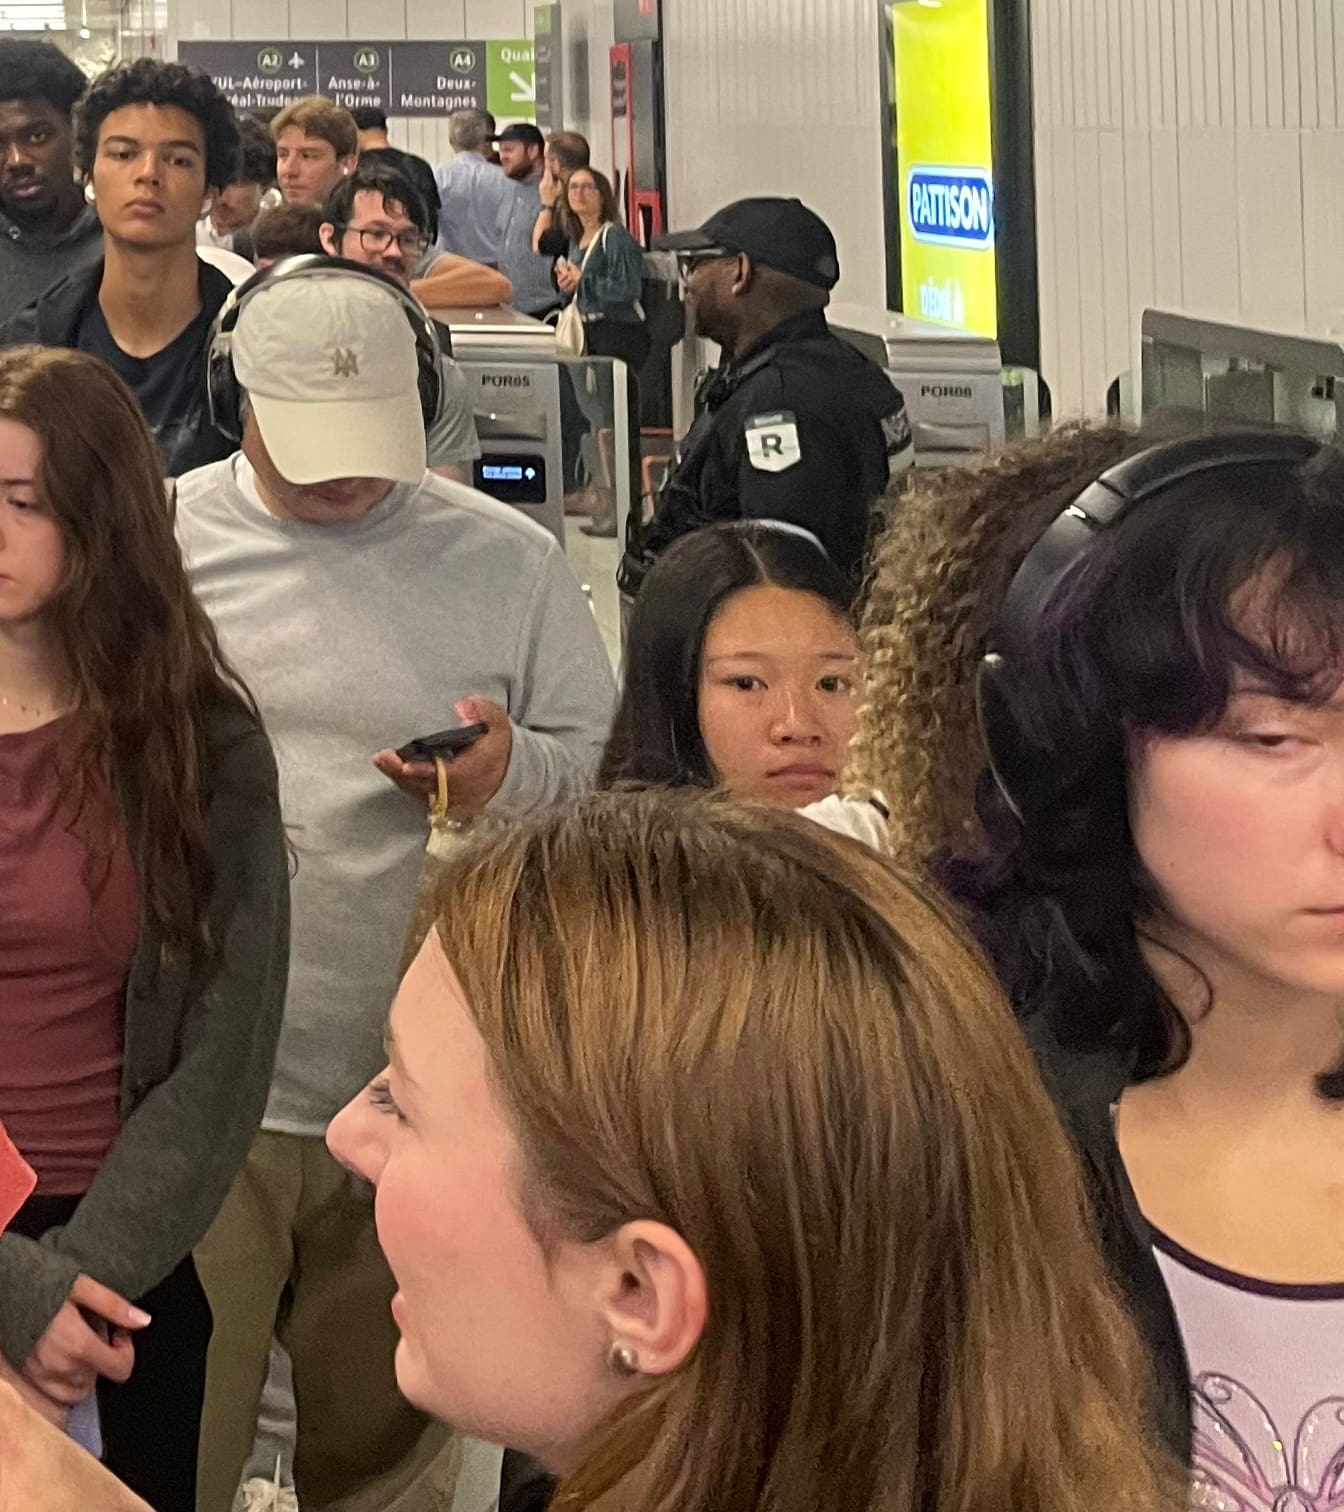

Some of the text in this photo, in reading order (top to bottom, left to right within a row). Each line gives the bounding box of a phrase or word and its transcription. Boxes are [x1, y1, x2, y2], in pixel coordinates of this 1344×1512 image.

[262, 53, 278, 67] A2
[454, 53, 471, 67] A4
[436, 76, 477, 90] Deux-
[400, 93, 477, 111] Montagnes
[912, 183, 989, 233] PATTISON
[761, 433, 784, 458] R
